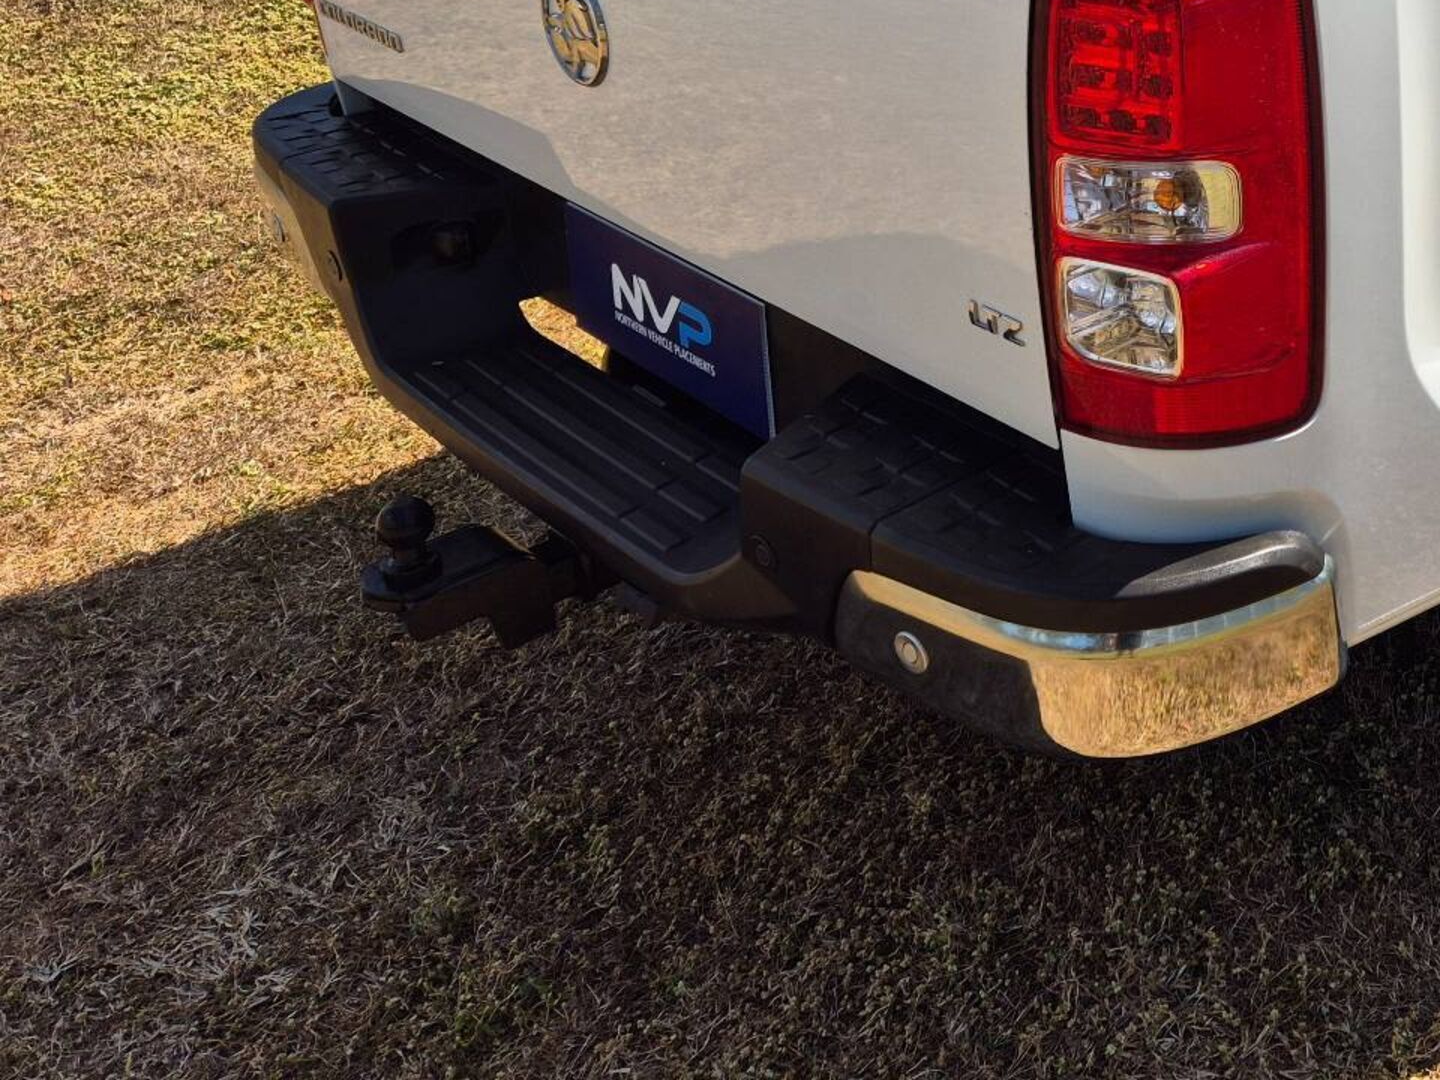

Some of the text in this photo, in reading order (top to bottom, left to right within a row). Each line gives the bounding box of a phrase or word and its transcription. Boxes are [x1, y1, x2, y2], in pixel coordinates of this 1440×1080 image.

[611, 263, 712, 348] NVP
[614, 309, 716, 377] NORTHERN VEHICLE PLACEMENTS
